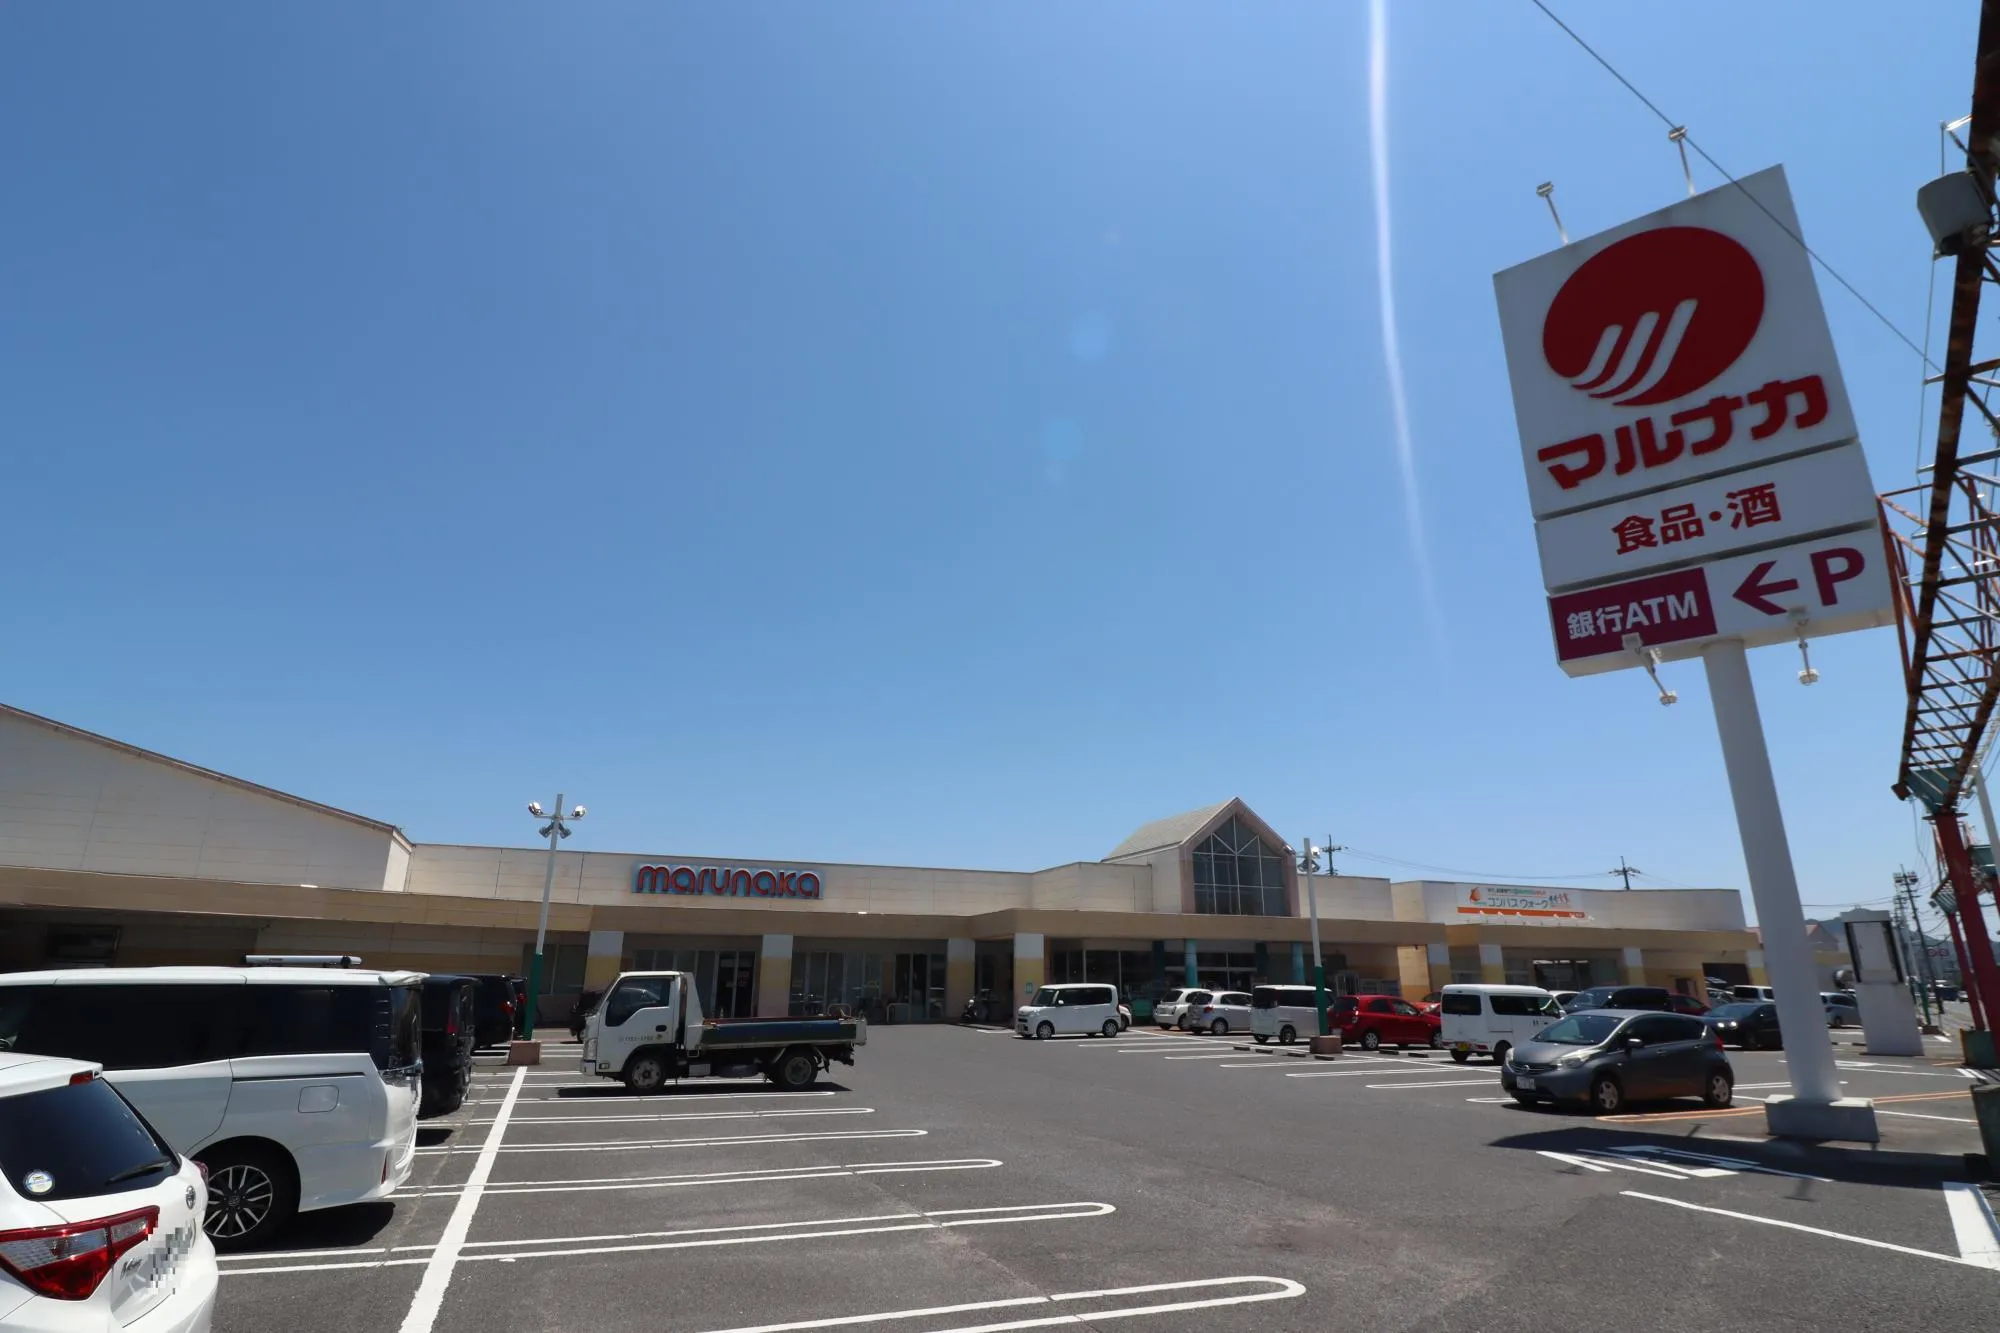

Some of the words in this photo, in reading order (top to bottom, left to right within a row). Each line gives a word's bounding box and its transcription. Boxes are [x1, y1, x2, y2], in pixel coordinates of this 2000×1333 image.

[1537, 374, 1829, 491] マルナカ
[1612, 482, 1782, 555] 食品・酒
[1809, 547, 1866, 607] P
[1566, 590, 1699, 640] 銀行ATM
[637, 865, 820, 898] marunaka
